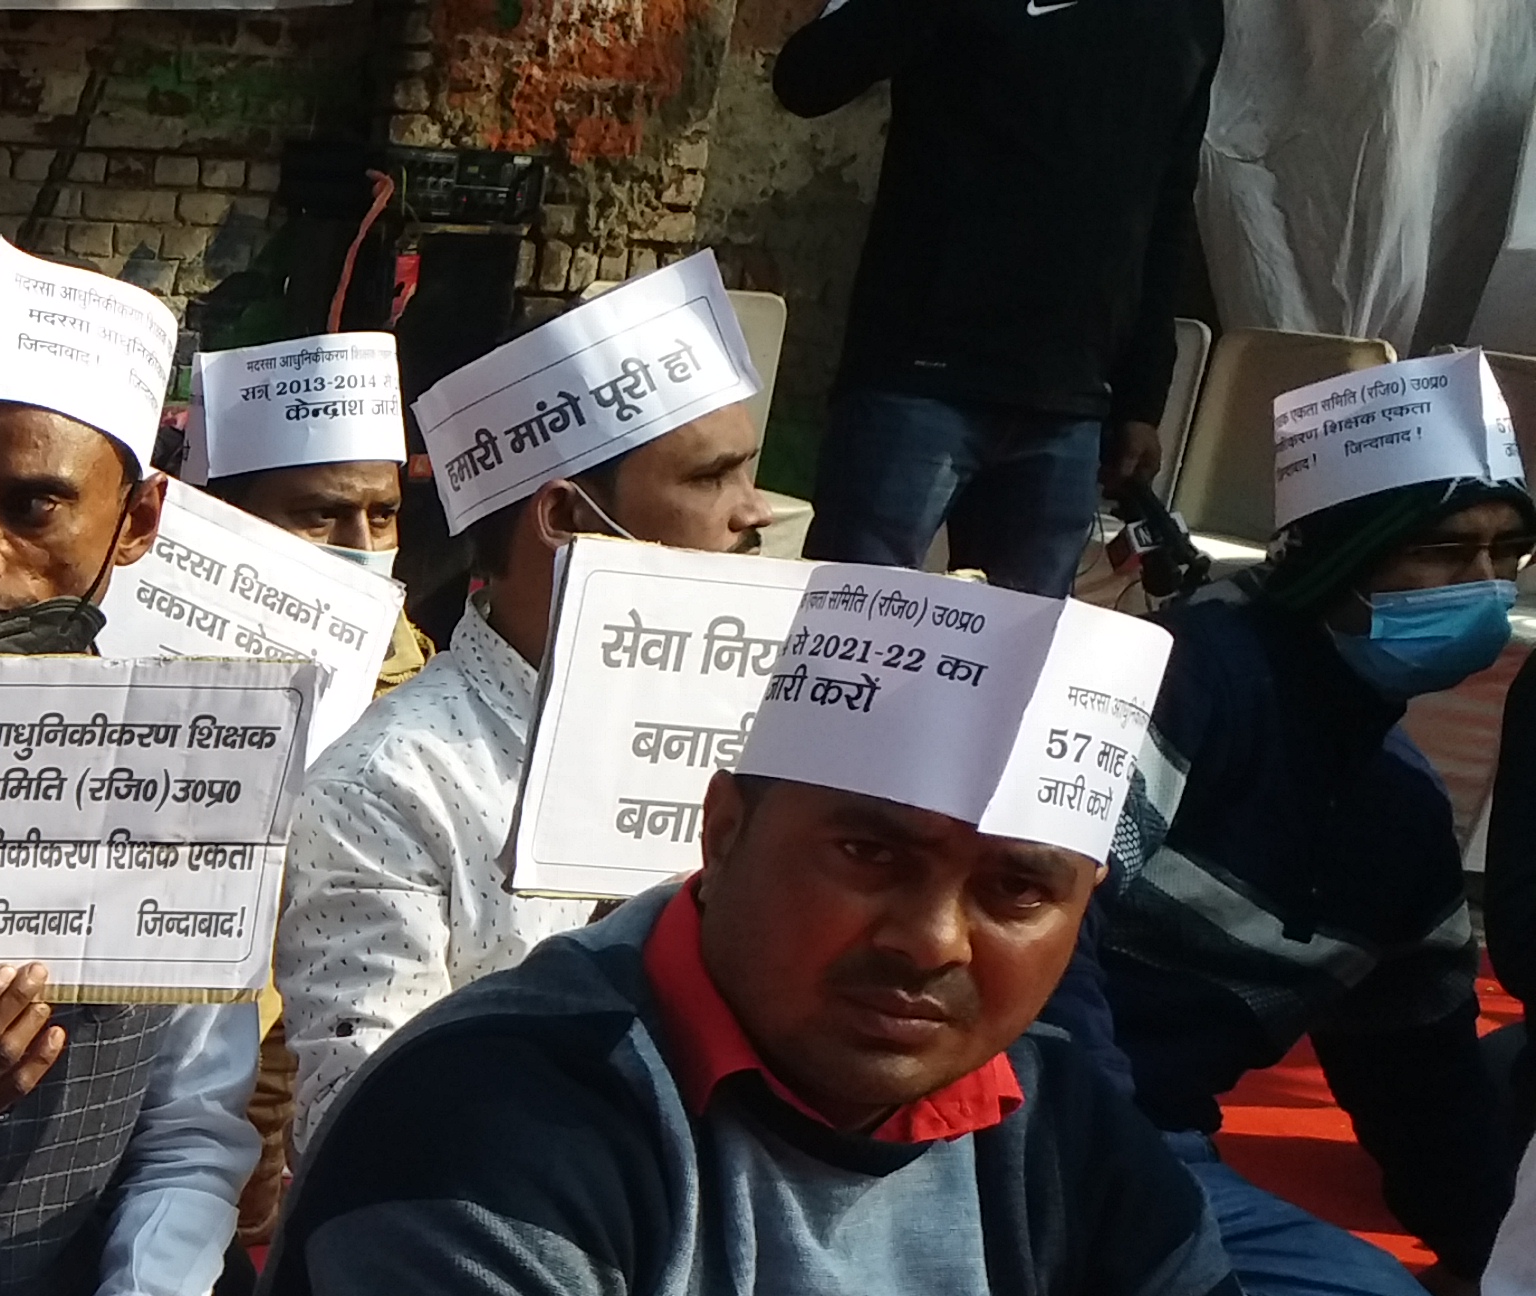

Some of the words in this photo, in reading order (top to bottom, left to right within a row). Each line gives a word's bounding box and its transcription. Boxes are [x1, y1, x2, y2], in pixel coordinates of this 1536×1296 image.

[276, 374, 377, 396] 2013-2014
[445, 428, 502, 493] हमारी
[503, 391, 586, 454] मांगे
[588, 356, 658, 422] पूरी
[657, 338, 702, 384] हो
[1323, 412, 1377, 437] शिक्षक
[1380, 402, 1432, 423] एकता
[136, 578, 230, 642] बकाया
[229, 563, 330, 631] शिक्षकों
[328, 615, 368, 651] का
[601, 608, 692, 672] सेवा
[809, 633, 927, 674] 2021-22
[937, 654, 988, 687] का
[187, 714, 281, 750] शिक्षक
[105, 829, 180, 870] शिक्षक
[188, 842, 255, 871] एकता
[136, 899, 245, 938] जिन्दाबाद!
